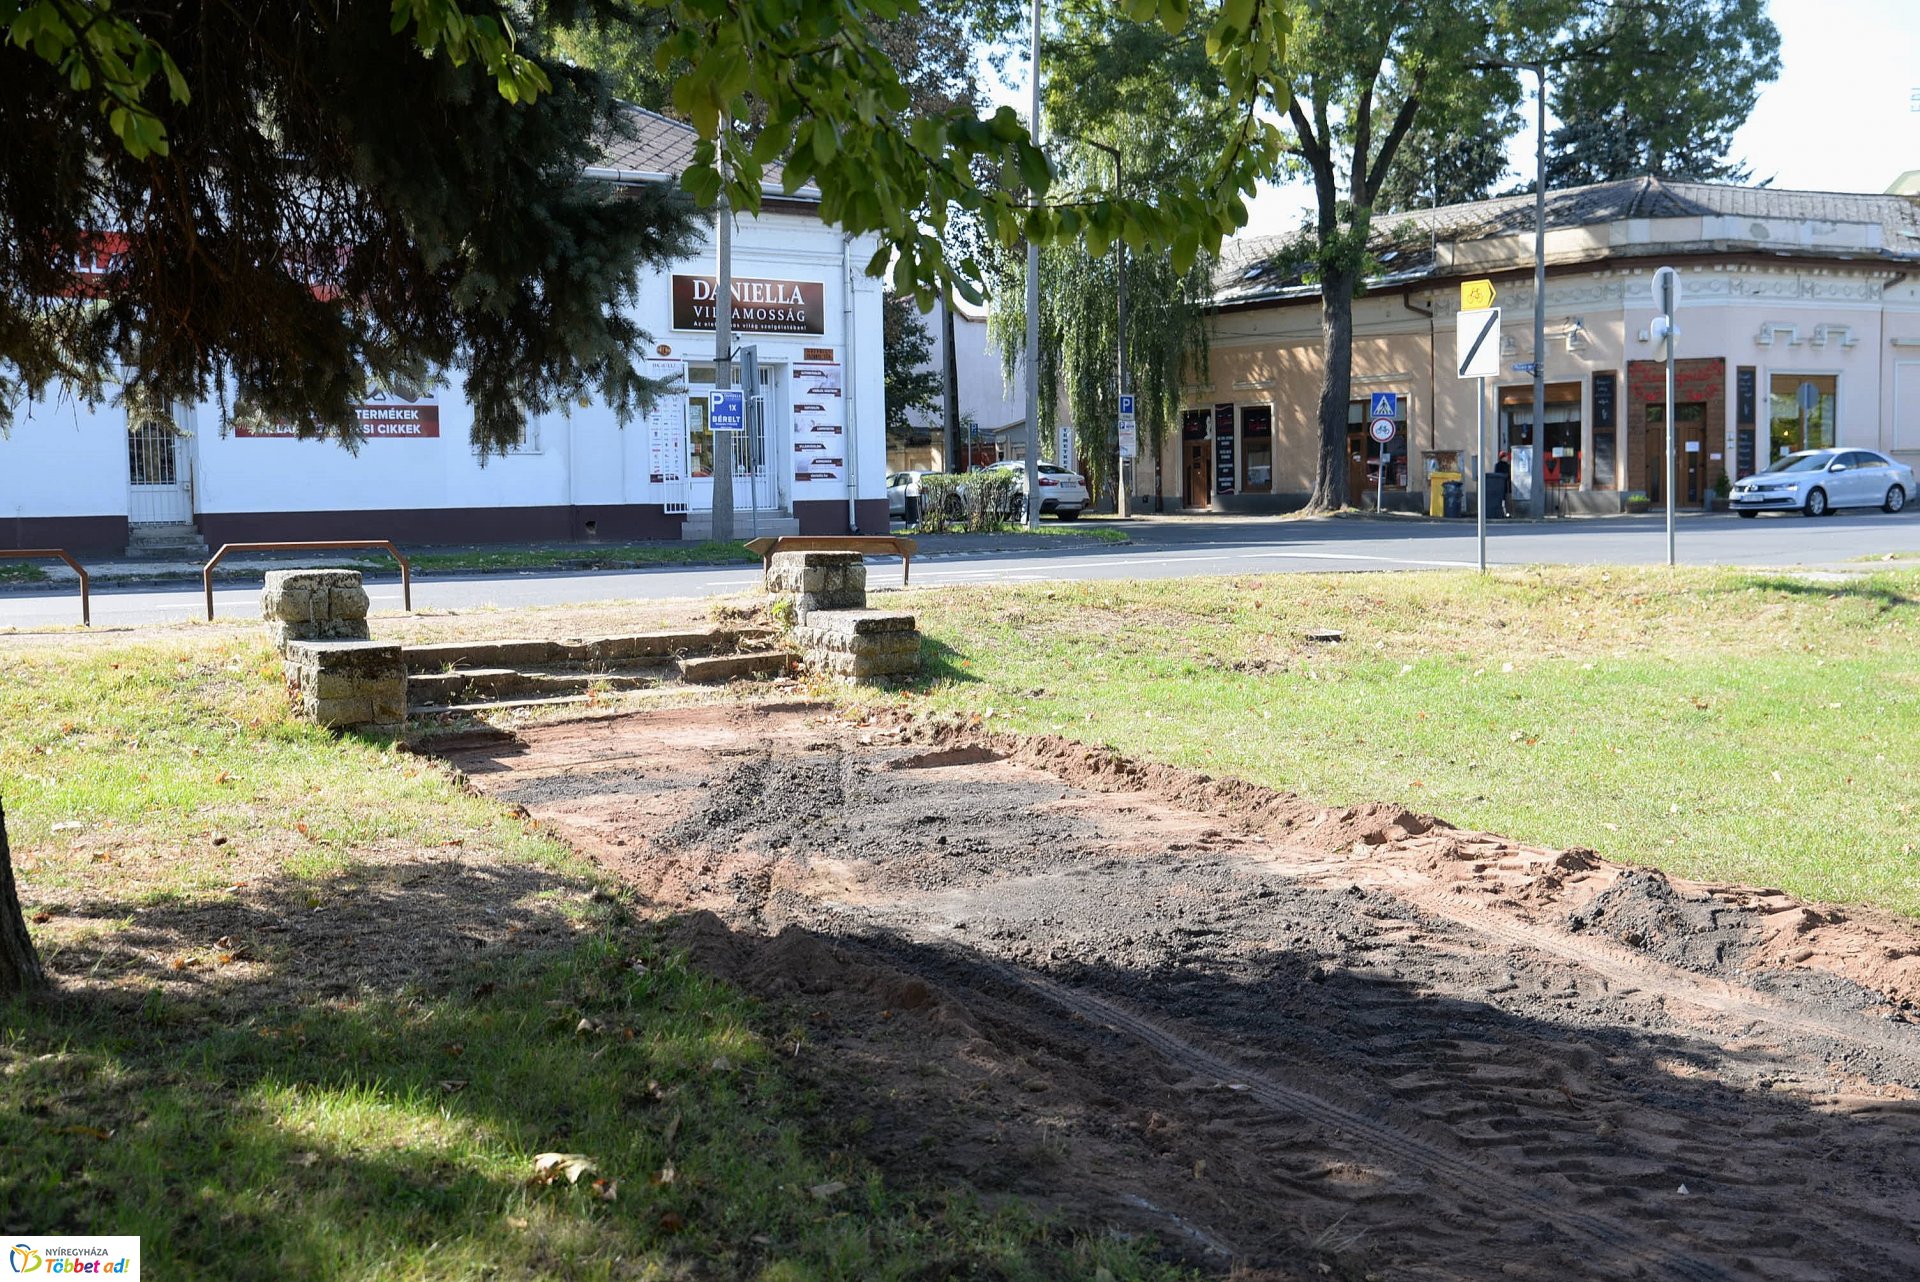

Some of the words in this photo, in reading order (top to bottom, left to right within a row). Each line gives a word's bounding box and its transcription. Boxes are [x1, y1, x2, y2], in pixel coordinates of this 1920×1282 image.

[693, 305, 806, 322] VILAMOSSÁG
[711, 393, 724, 413] P
[728, 404, 737, 412] 1X
[1123, 398, 1131, 412] P
[355, 407, 419, 420] TERMÉKEK
[712, 415, 741, 423] BÉRELT
[377, 424, 421, 434] CIKKEK
